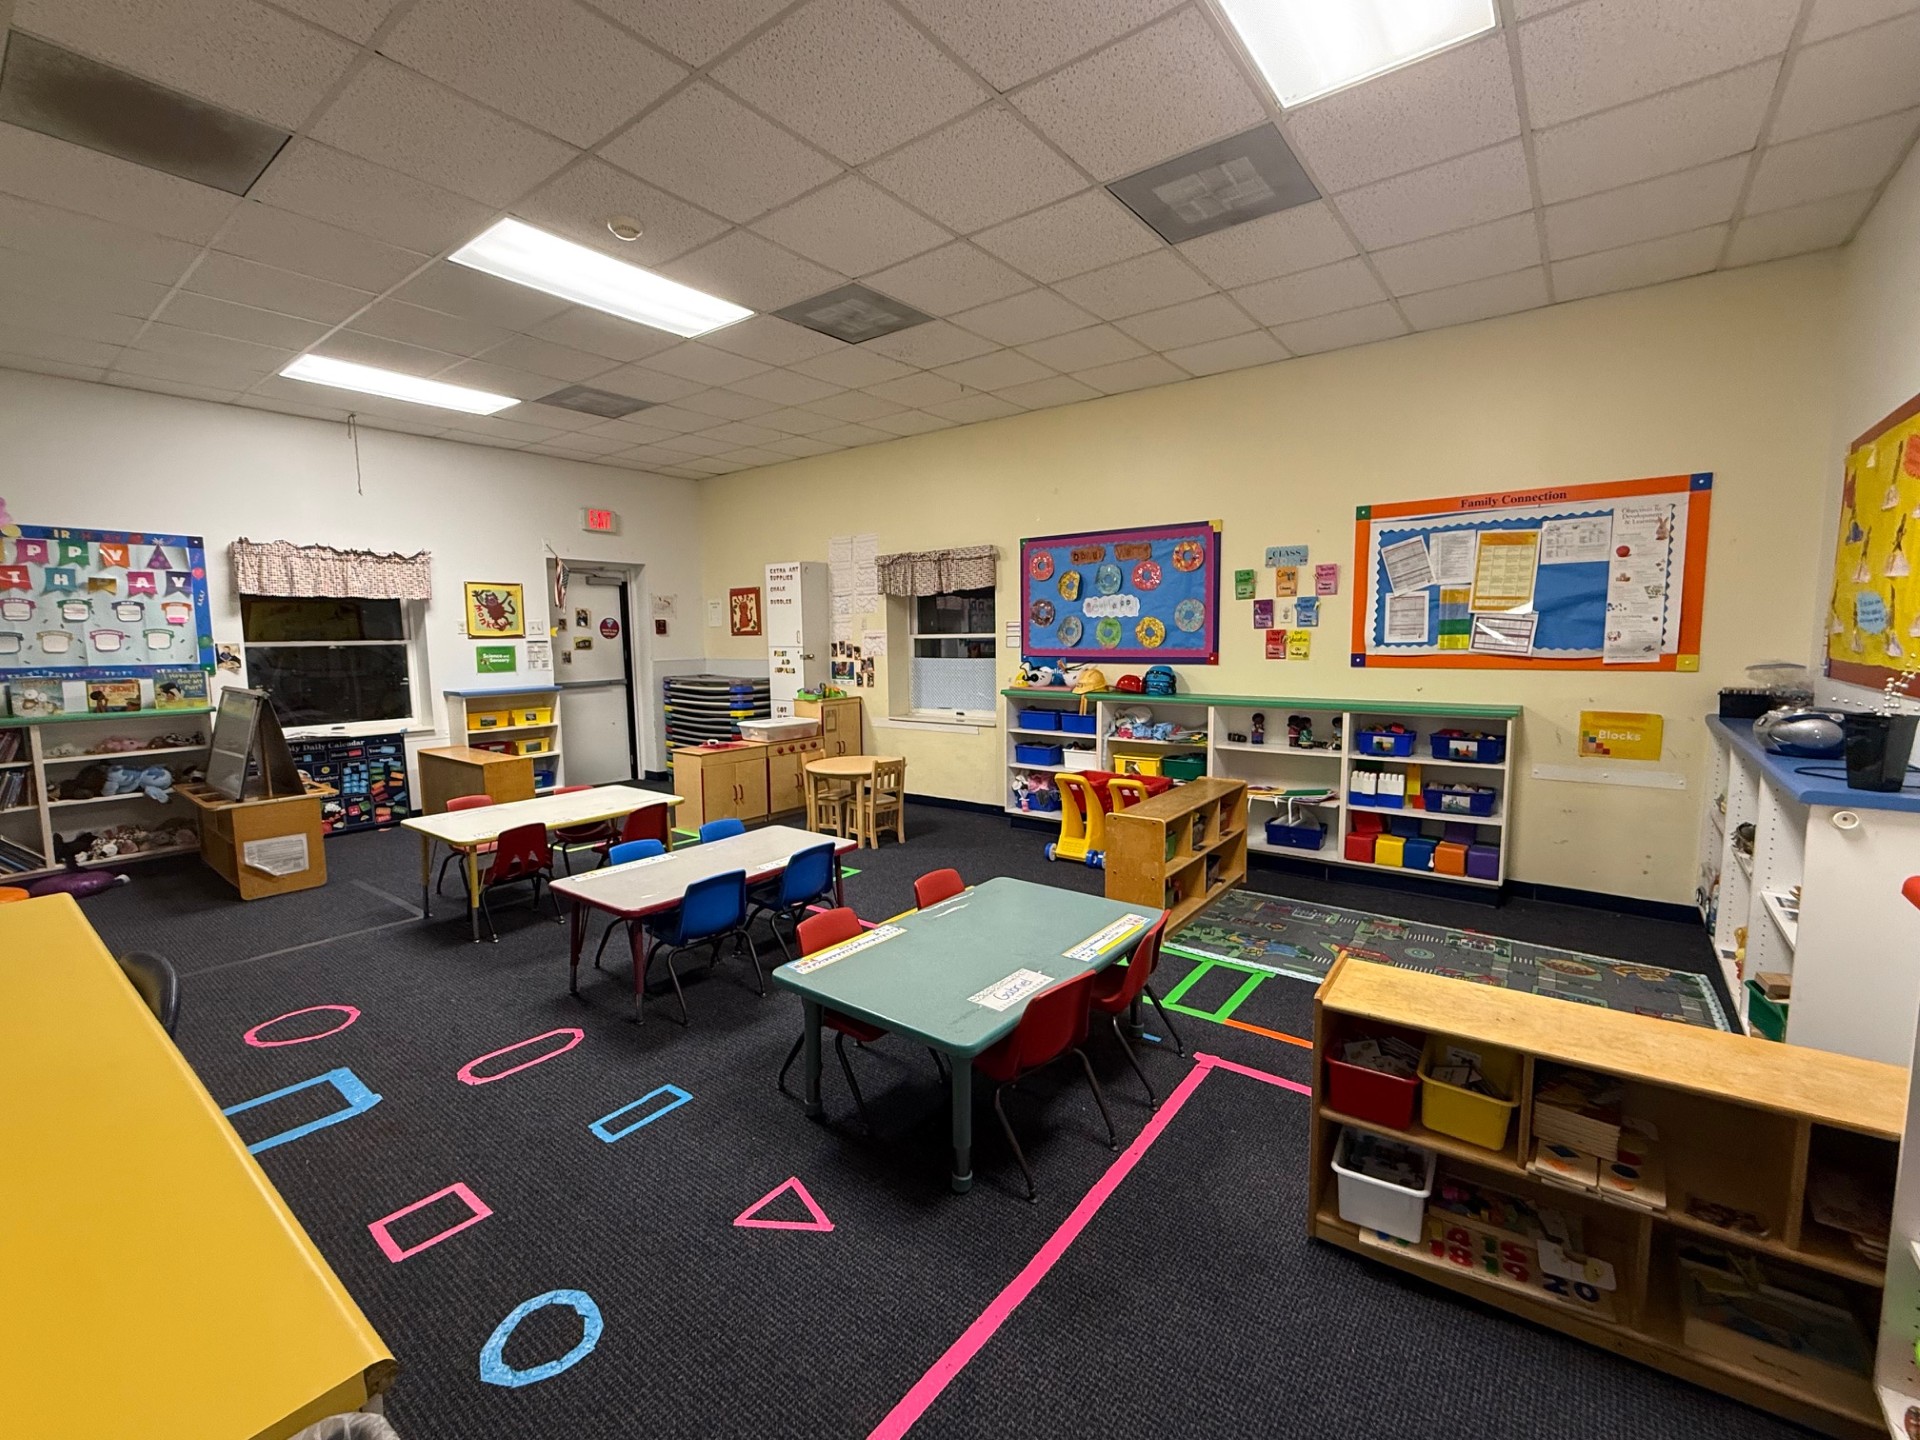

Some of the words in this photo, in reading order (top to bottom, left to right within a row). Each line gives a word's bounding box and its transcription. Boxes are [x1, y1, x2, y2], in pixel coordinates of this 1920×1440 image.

[1460, 497, 1498, 508] Family
[1502, 491, 1567, 504] Connection
[588, 508, 611, 529] EXIT
[1272, 550, 1302, 558] CLASS
[1597, 729, 1641, 742] Blocks
[302, 742, 326, 752] Daily
[327, 739, 366, 749] Calendar
